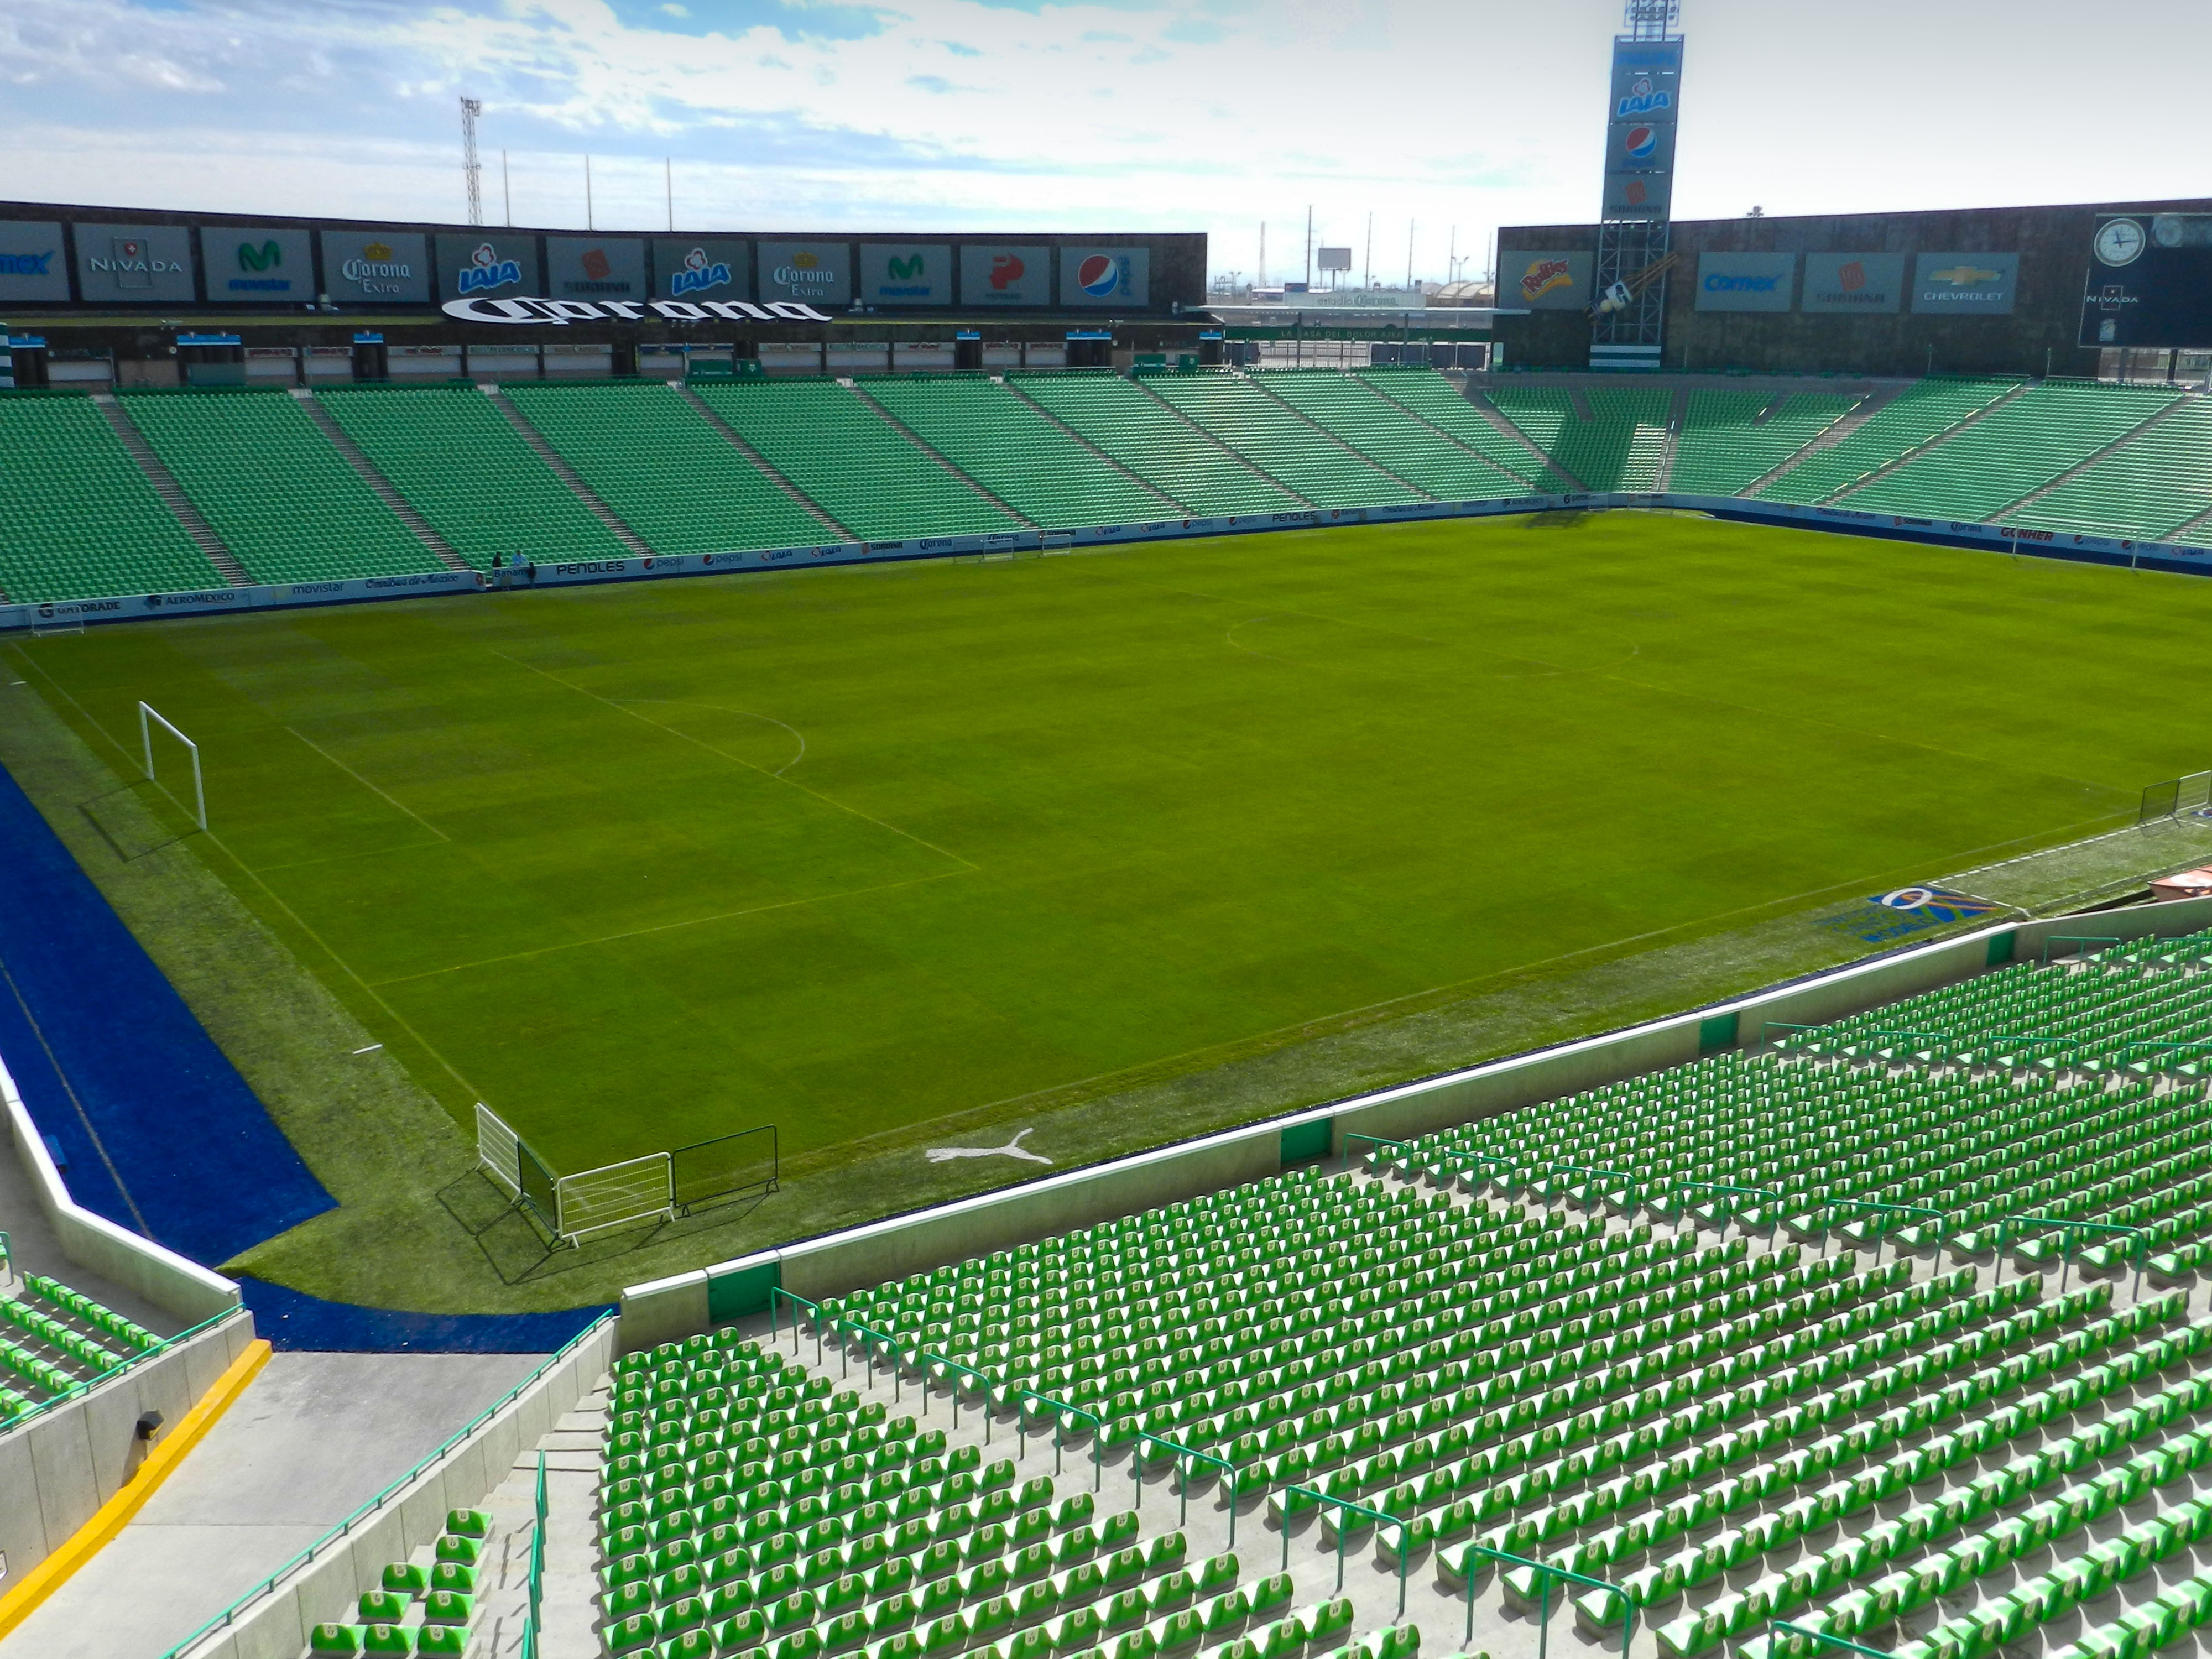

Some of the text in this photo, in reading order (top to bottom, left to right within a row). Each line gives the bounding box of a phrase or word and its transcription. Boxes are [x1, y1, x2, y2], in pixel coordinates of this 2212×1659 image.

[90, 258, 181, 273] NIVADA
[342, 259, 411, 280] Corona
[458, 261, 521, 294] LALA
[672, 263, 731, 296] LALA
[774, 267, 833, 285] Corona
[229, 279, 291, 291] movistar
[363, 280, 399, 293] Extra
[564, 281, 630, 293] SORIANA
[1704, 273, 1783, 293] Comex
[791, 285, 823, 297] Extra
[880, 285, 931, 298] movistar
[1924, 292, 2004, 302] CHEVROLET
[1816, 294, 1885, 304] SORIANA
[2086, 295, 2138, 304] NIVADA
[442, 296, 833, 325] Corona
[870, 542, 903, 551] SORIANA
[919, 538, 952, 550] Corona
[656, 557, 684, 568] pepsi
[716, 554, 742, 565] pepsi
[293, 581, 344, 595] movistar
[57, 601, 121, 614] GATORADE
